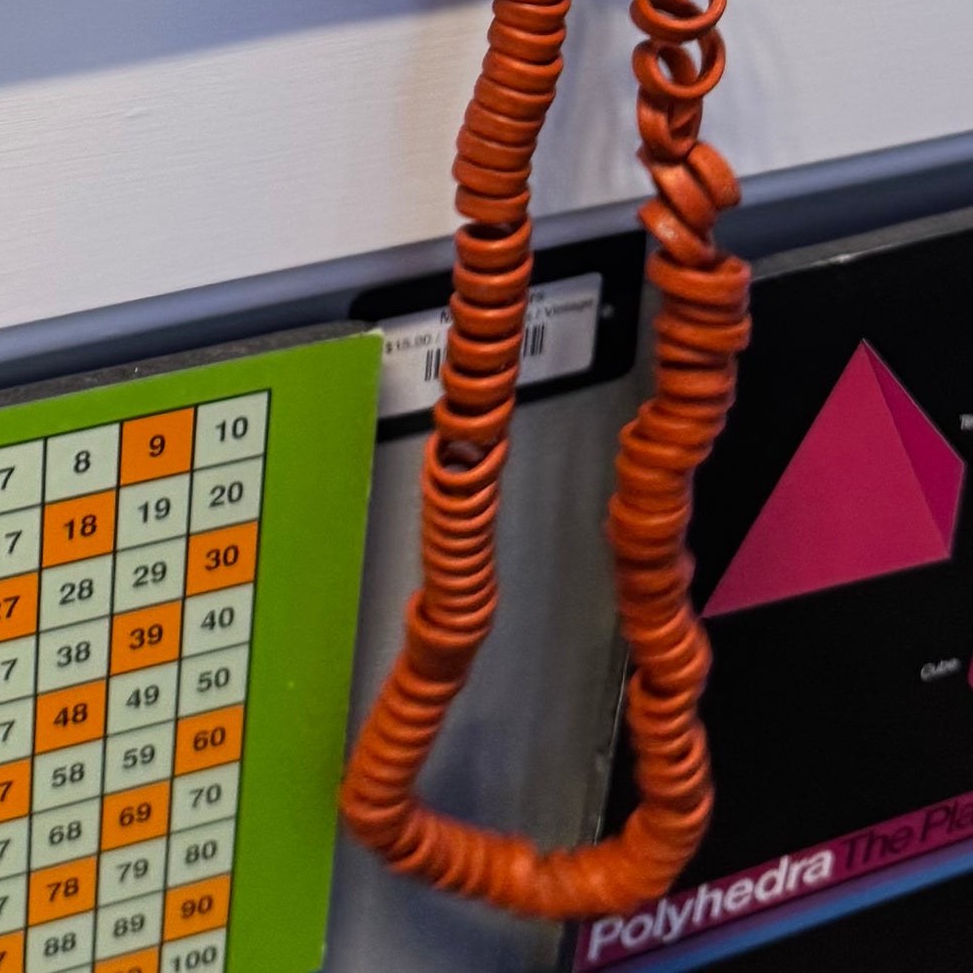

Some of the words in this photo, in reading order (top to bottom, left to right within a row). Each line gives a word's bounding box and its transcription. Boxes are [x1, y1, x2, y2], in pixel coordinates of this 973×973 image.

[72, 449, 92, 475] 8
[149, 434, 166, 458] 9
[215, 415, 249, 443] 10
[65, 514, 97, 540] 18
[137, 496, 172, 524] 19
[208, 480, 245, 509] 20
[58, 578, 95, 607] 28
[131, 560, 168, 590] 29
[205, 544, 239, 572] 30
[56, 640, 92, 669] 38
[129, 624, 164, 651] 39
[199, 606, 236, 632] 40
[53, 703, 88, 727] 48
[125, 684, 161, 710] 49
[195, 666, 232, 694] 50
[50, 761, 86, 790] 58
[121, 743, 156, 771] 59
[192, 727, 226, 752] 60
[47, 820, 83, 847] 68
[118, 803, 152, 827] 69
[189, 782, 223, 809] 70
[49, 878, 79, 902] 78
[116, 858, 150, 884] 79
[183, 839, 219, 868] 80
[587, 849, 833, 962] Polyhedra
[840, 826, 914, 869] The
[42, 931, 77, 959] 88
[112, 913, 147, 940] 89
[181, 896, 213, 919] 90
[171, 945, 218, 973] 100
